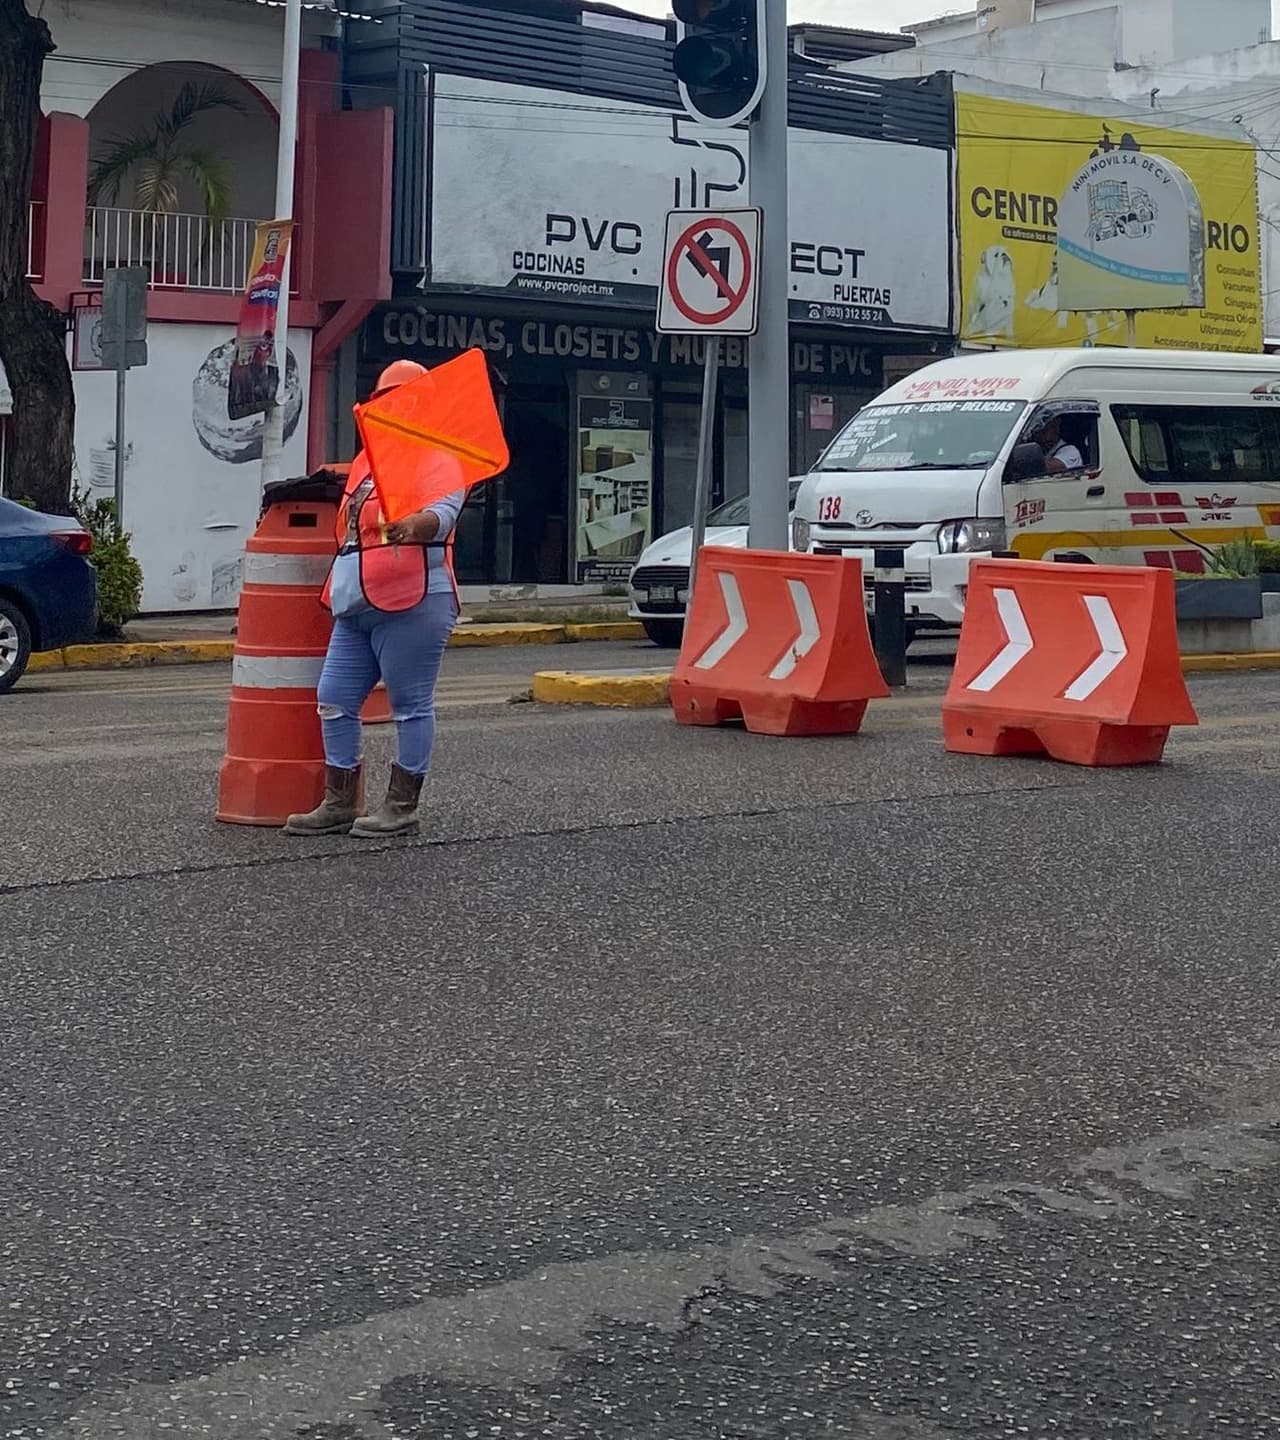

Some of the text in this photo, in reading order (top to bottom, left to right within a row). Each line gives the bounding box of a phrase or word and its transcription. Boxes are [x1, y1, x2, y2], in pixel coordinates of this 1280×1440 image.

[1071, 170, 1091, 193] MINI
[1141, 159, 1156, 172] DE
[971, 185, 1250, 253] CENTR RIO
[545, 213, 866, 279] PVC ECT
[512, 250, 892, 306] COCINAS PUERTAS
[517, 276, 615, 297] www.pvcproject.mx
[1223, 280, 1256, 294] Vacunas
[822, 306, 884, 321] (993) 312 55 24
[383, 311, 514, 359] COCINAS,
[521, 321, 641, 362] CLOSETS
[647, 331, 663, 362] Y
[793, 342, 825, 373] DE
[830, 344, 872, 376] PVC
[818, 495, 842, 521] 138
